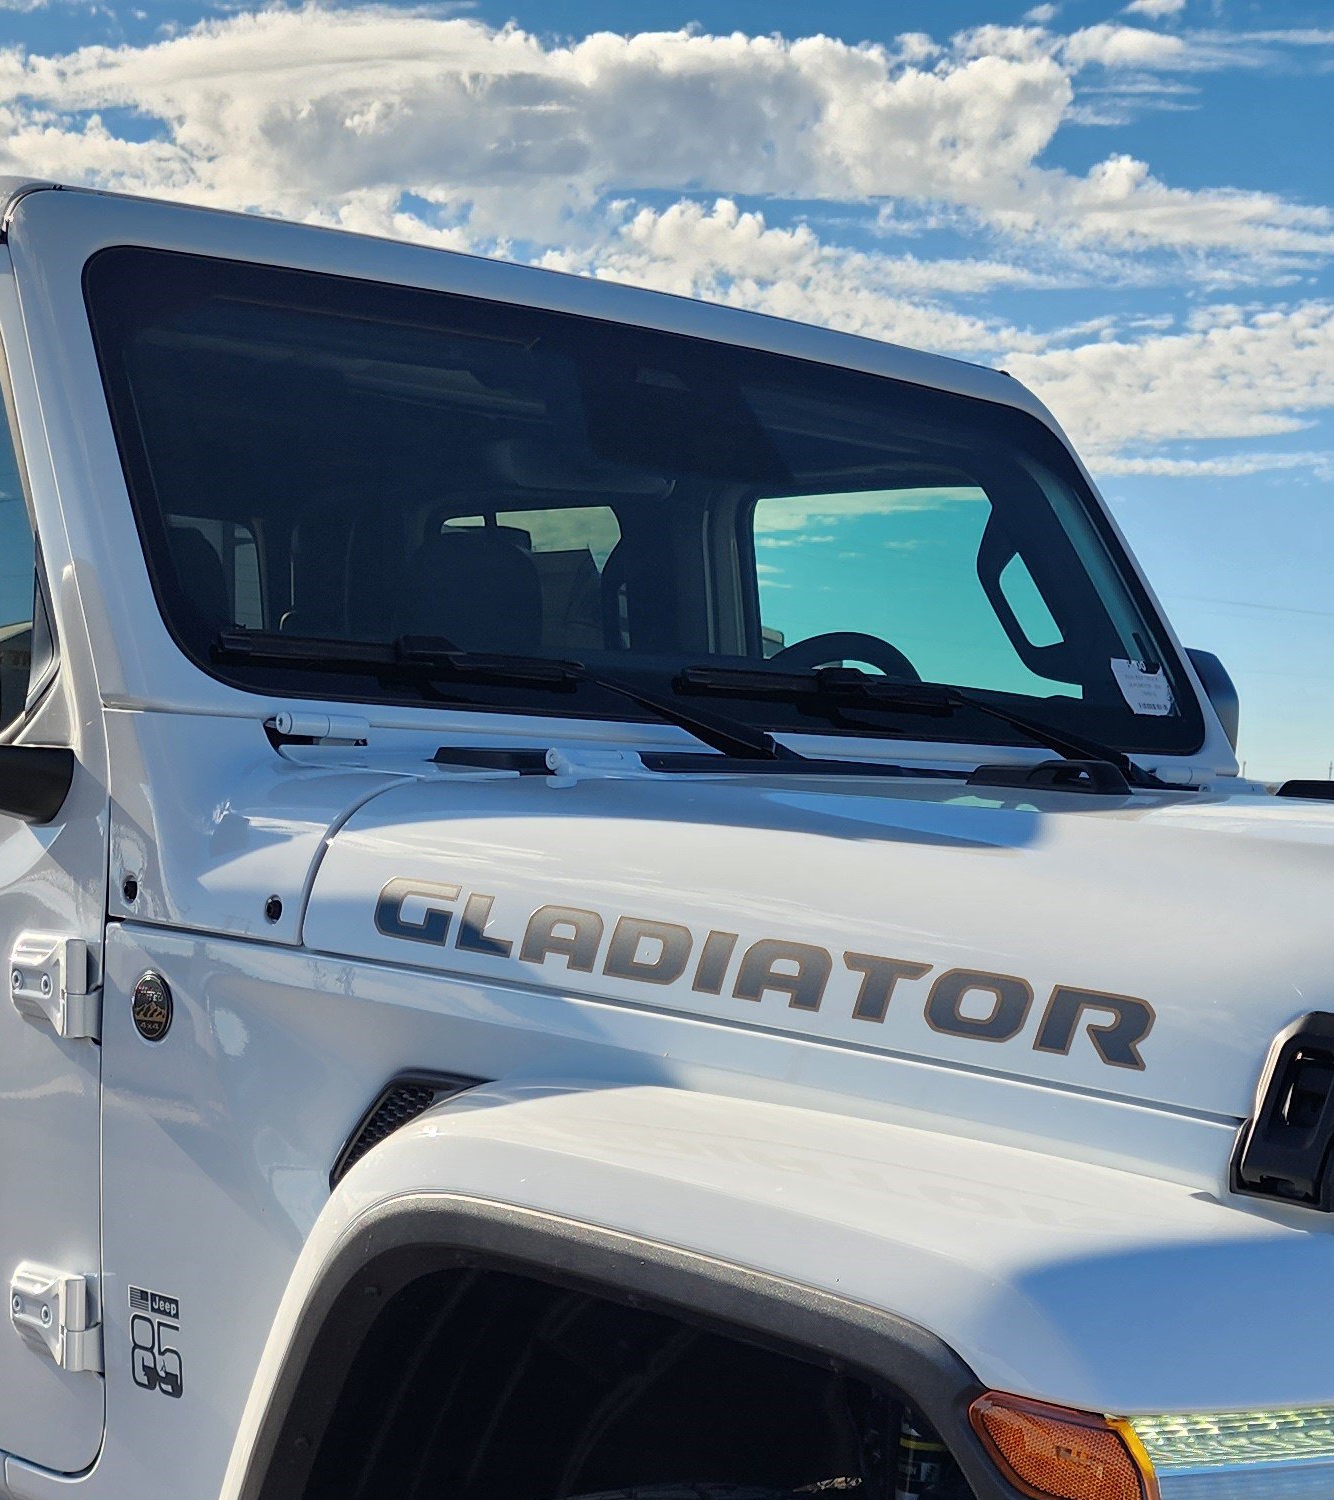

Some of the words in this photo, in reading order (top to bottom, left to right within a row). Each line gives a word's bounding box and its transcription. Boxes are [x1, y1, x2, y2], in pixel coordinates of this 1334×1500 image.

[373, 875, 1157, 1071] GLADIATOR
[152, 1296, 177, 1316] Jeep
[130, 1313, 183, 1398] 85
